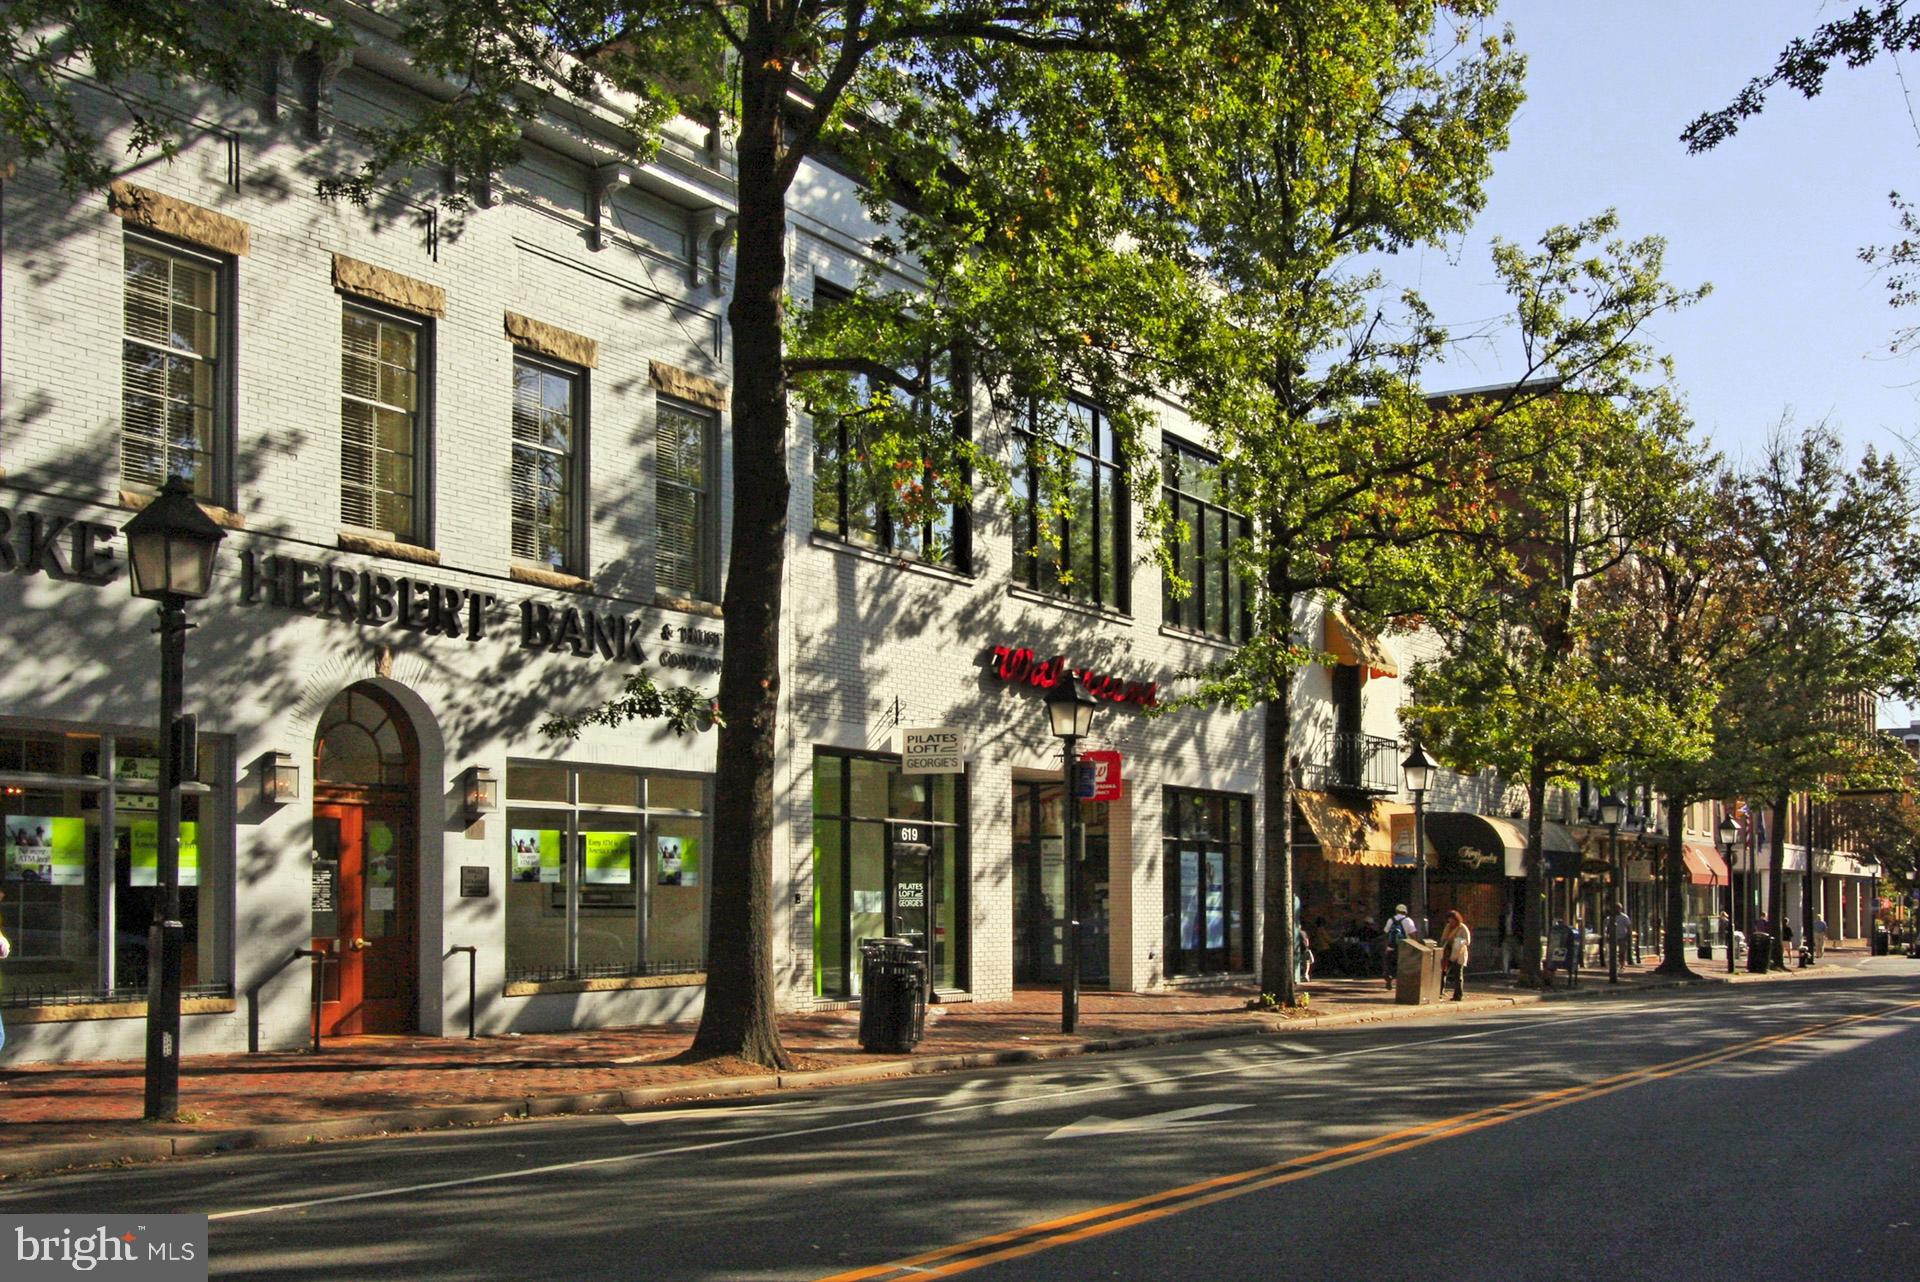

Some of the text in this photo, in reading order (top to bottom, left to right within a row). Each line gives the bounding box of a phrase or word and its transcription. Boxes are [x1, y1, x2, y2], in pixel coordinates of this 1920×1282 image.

[237, 551, 497, 641] HERBERT
[519, 599, 648, 665] BANK
[660, 623, 673, 641] &
[907, 733, 958, 744] PILATES
[907, 744, 939, 753] LOFT
[906, 757, 959, 768] GEORGIE'S
[901, 828, 918, 841] 619
[898, 890, 914, 898] LOFT
